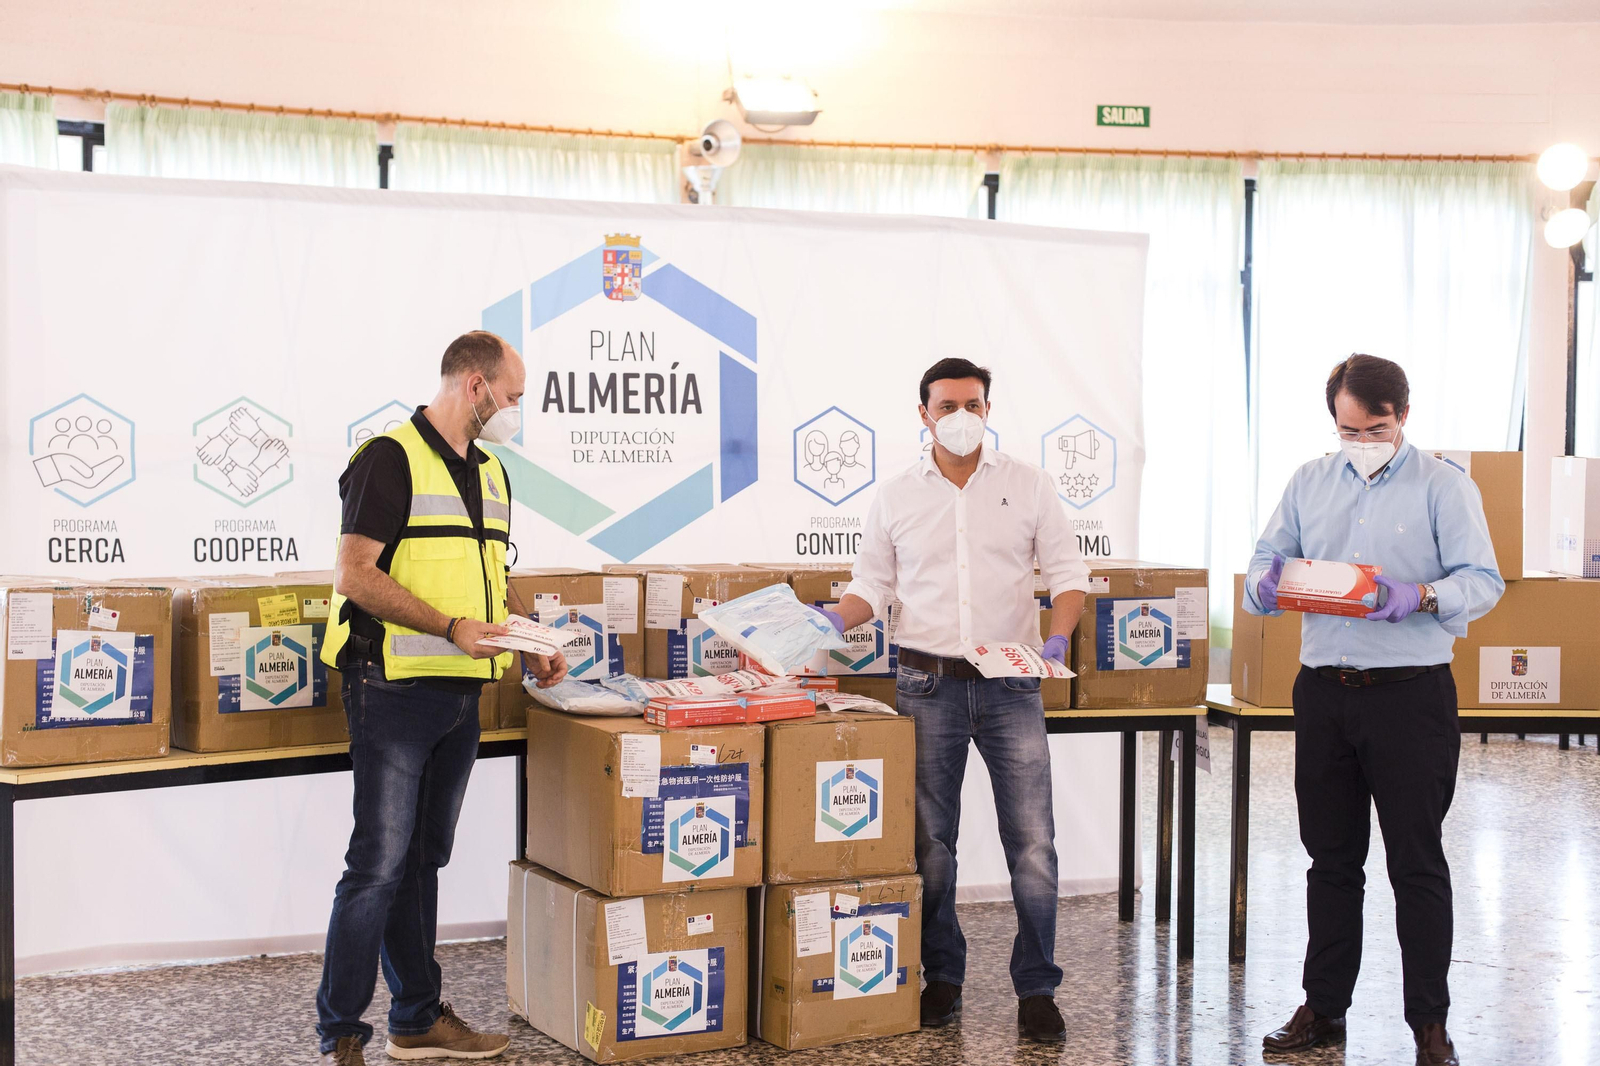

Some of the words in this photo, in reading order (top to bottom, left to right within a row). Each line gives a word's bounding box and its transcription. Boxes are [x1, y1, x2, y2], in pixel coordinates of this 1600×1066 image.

[1102, 106, 1145, 125] SALIDA
[590, 330, 656, 362] PLAN
[541, 362, 703, 415] ALMERÍA
[570, 428, 675, 445] DIPUTACIÓN
[572, 449, 594, 464] DE
[600, 446, 673, 464] ALMERÍA
[53, 518, 118, 533] PROGRAMA
[214, 519, 277, 532] PROGRAMA
[810, 516, 862, 529] PROGRAMA
[1069, 519, 1104, 531] GRAMA
[48, 536, 126, 563] CERCA
[193, 536, 299, 563] COOPERA
[1130, 627, 1161, 639] ALMERÍA
[714, 640, 728, 648] PLAN
[268, 652, 285, 660] PLAN
[704, 647, 738, 659] ALMERÍA
[86, 658, 104, 667] PLAN
[258, 659, 295, 673] ALMERÍA
[1000, 647, 1030, 674] KN95
[74, 667, 113, 680] ALMERÍA
[1490, 680, 1548, 690] DIPUTACIÓN
[1492, 691, 1504, 699] DE
[1506, 690, 1546, 699] ALMERÍA
[658, 774, 742, 786] 急物资医用一次性防护服
[843, 785, 858, 793] PLAN
[833, 792, 866, 806] ALMERÍA
[692, 824, 708, 833] PLAN
[682, 830, 717, 846] ALMERÍA
[860, 941, 874, 949] PLAN
[850, 948, 882, 963] ALMERÍA
[665, 978, 681, 986] PLAN
[654, 984, 690, 999] ALMERÍA
